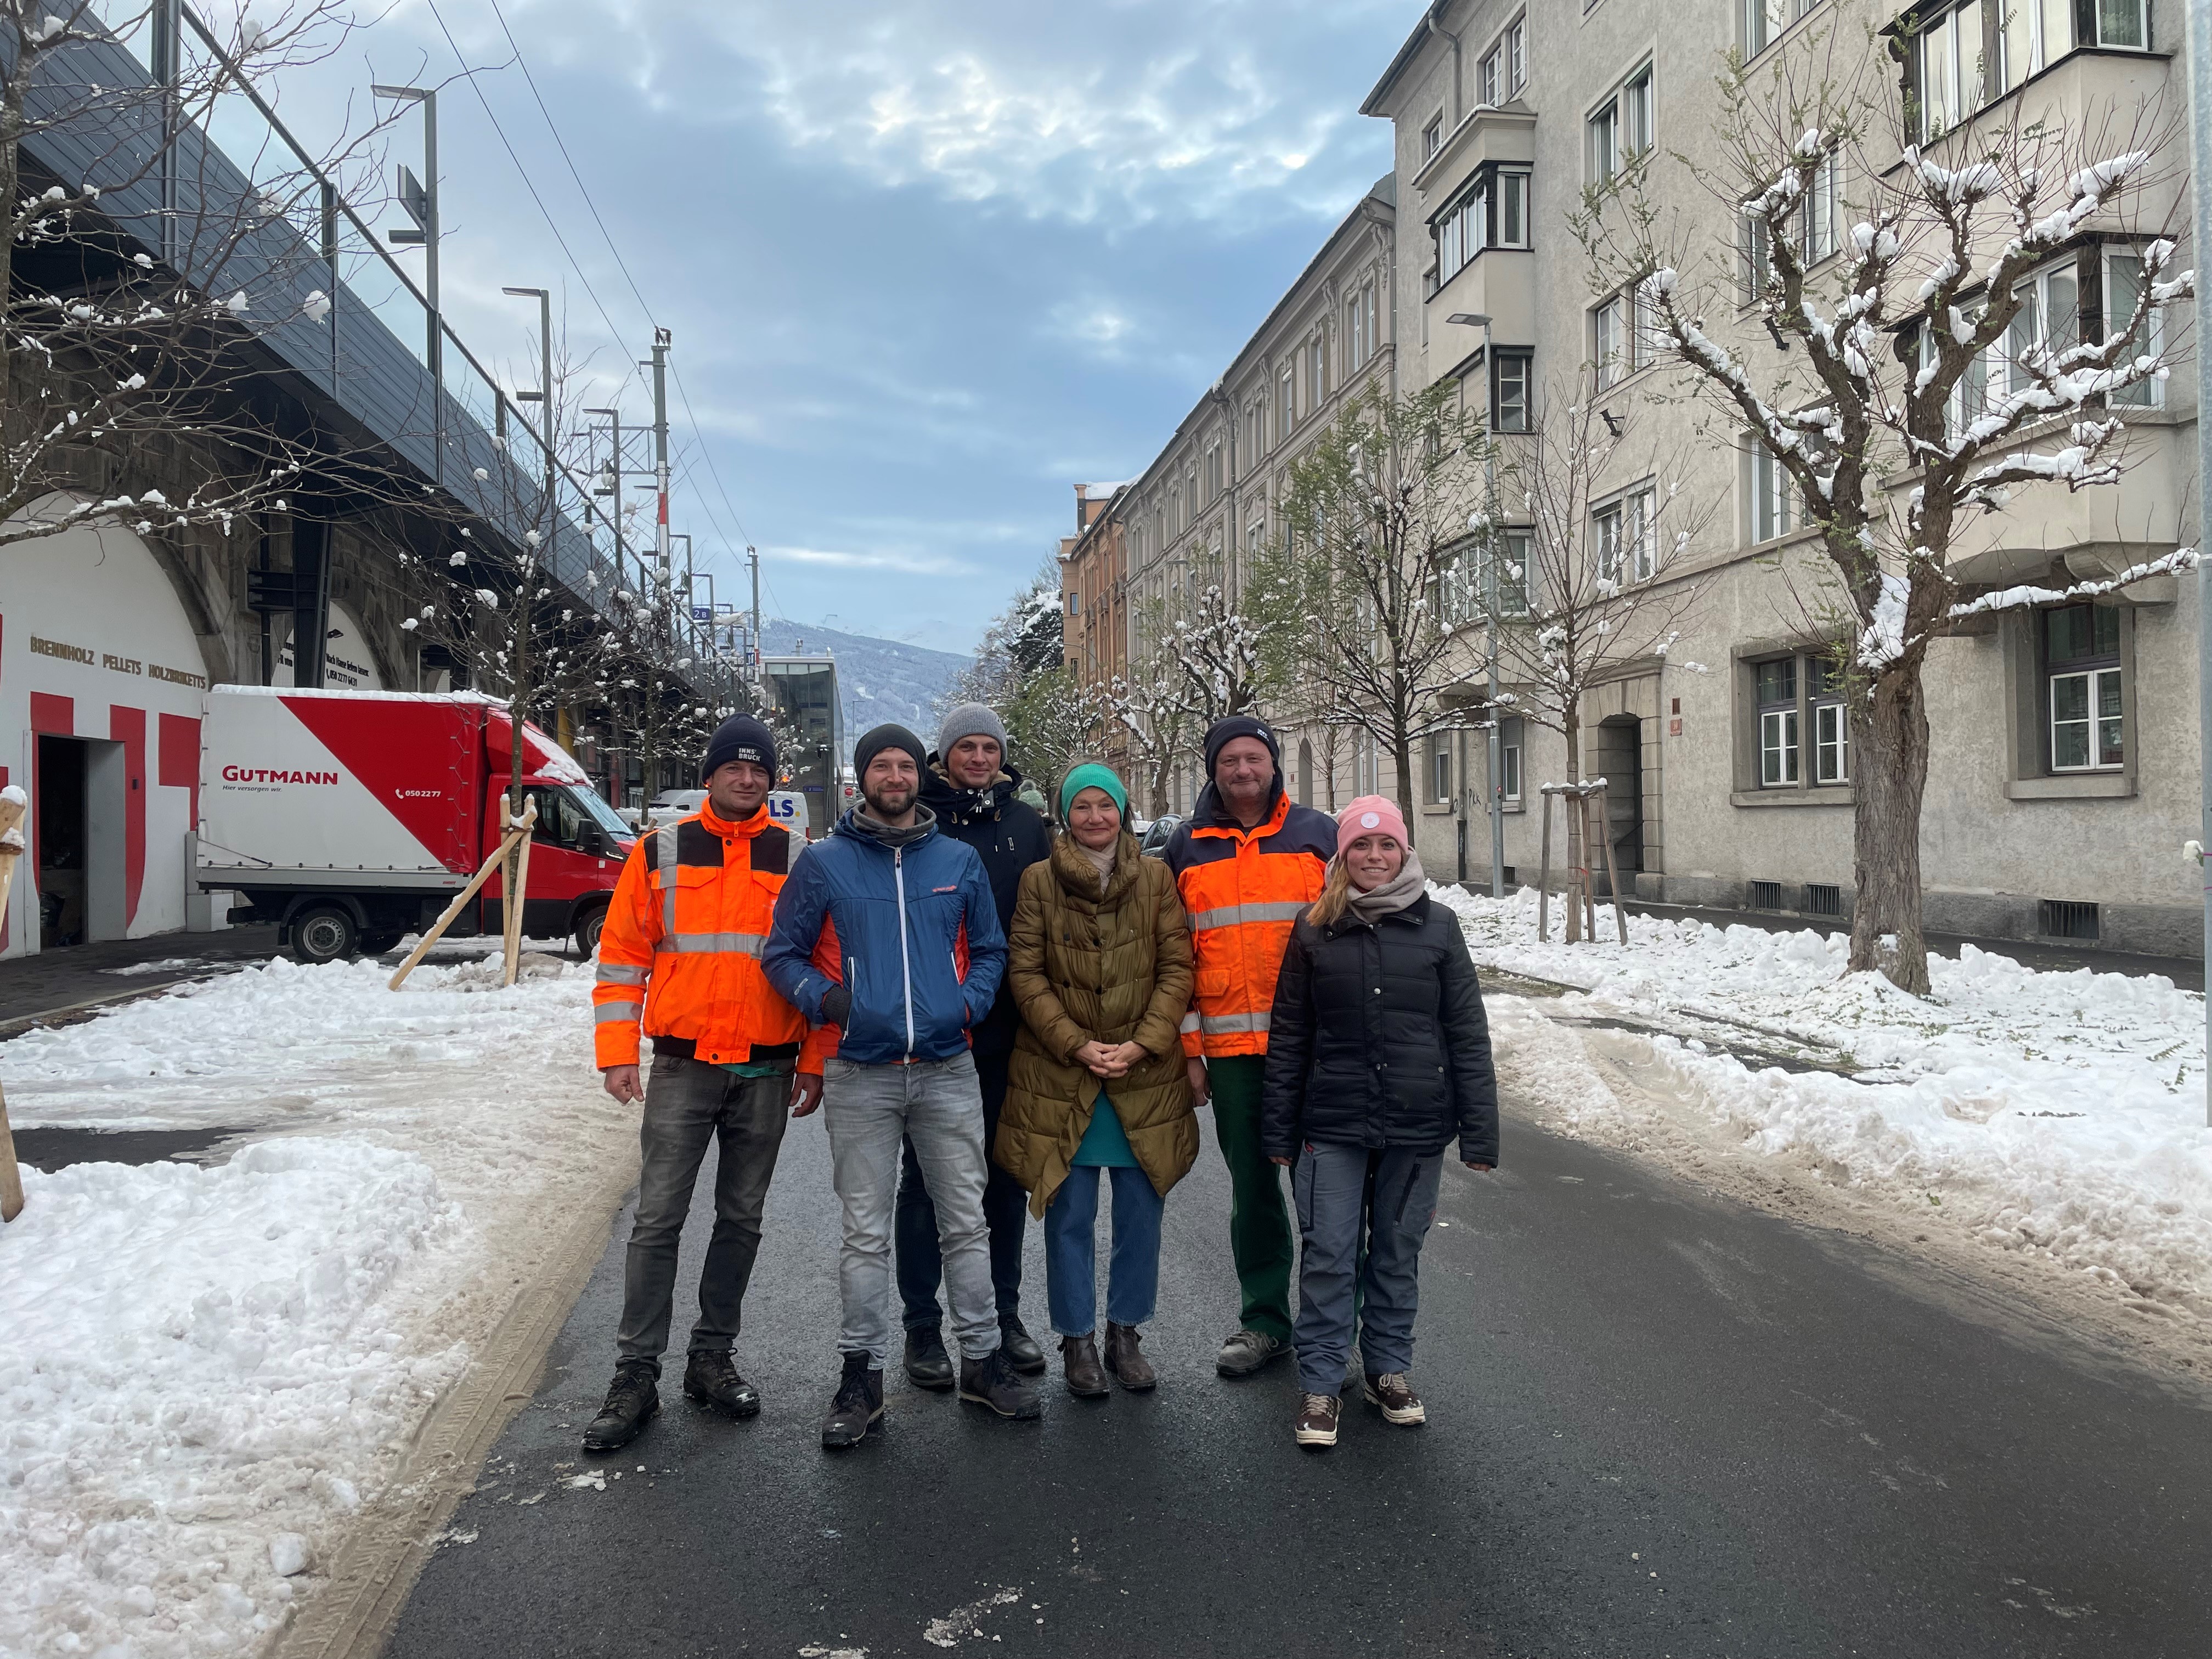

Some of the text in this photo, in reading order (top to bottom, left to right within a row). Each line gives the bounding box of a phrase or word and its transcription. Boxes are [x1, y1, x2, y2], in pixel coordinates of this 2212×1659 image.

[694, 610, 700, 618] 2
[30, 636, 206, 690] BRENNHOLZ PELLETS HOLZBRIKETTS
[738, 753, 761, 762] BRUCK
